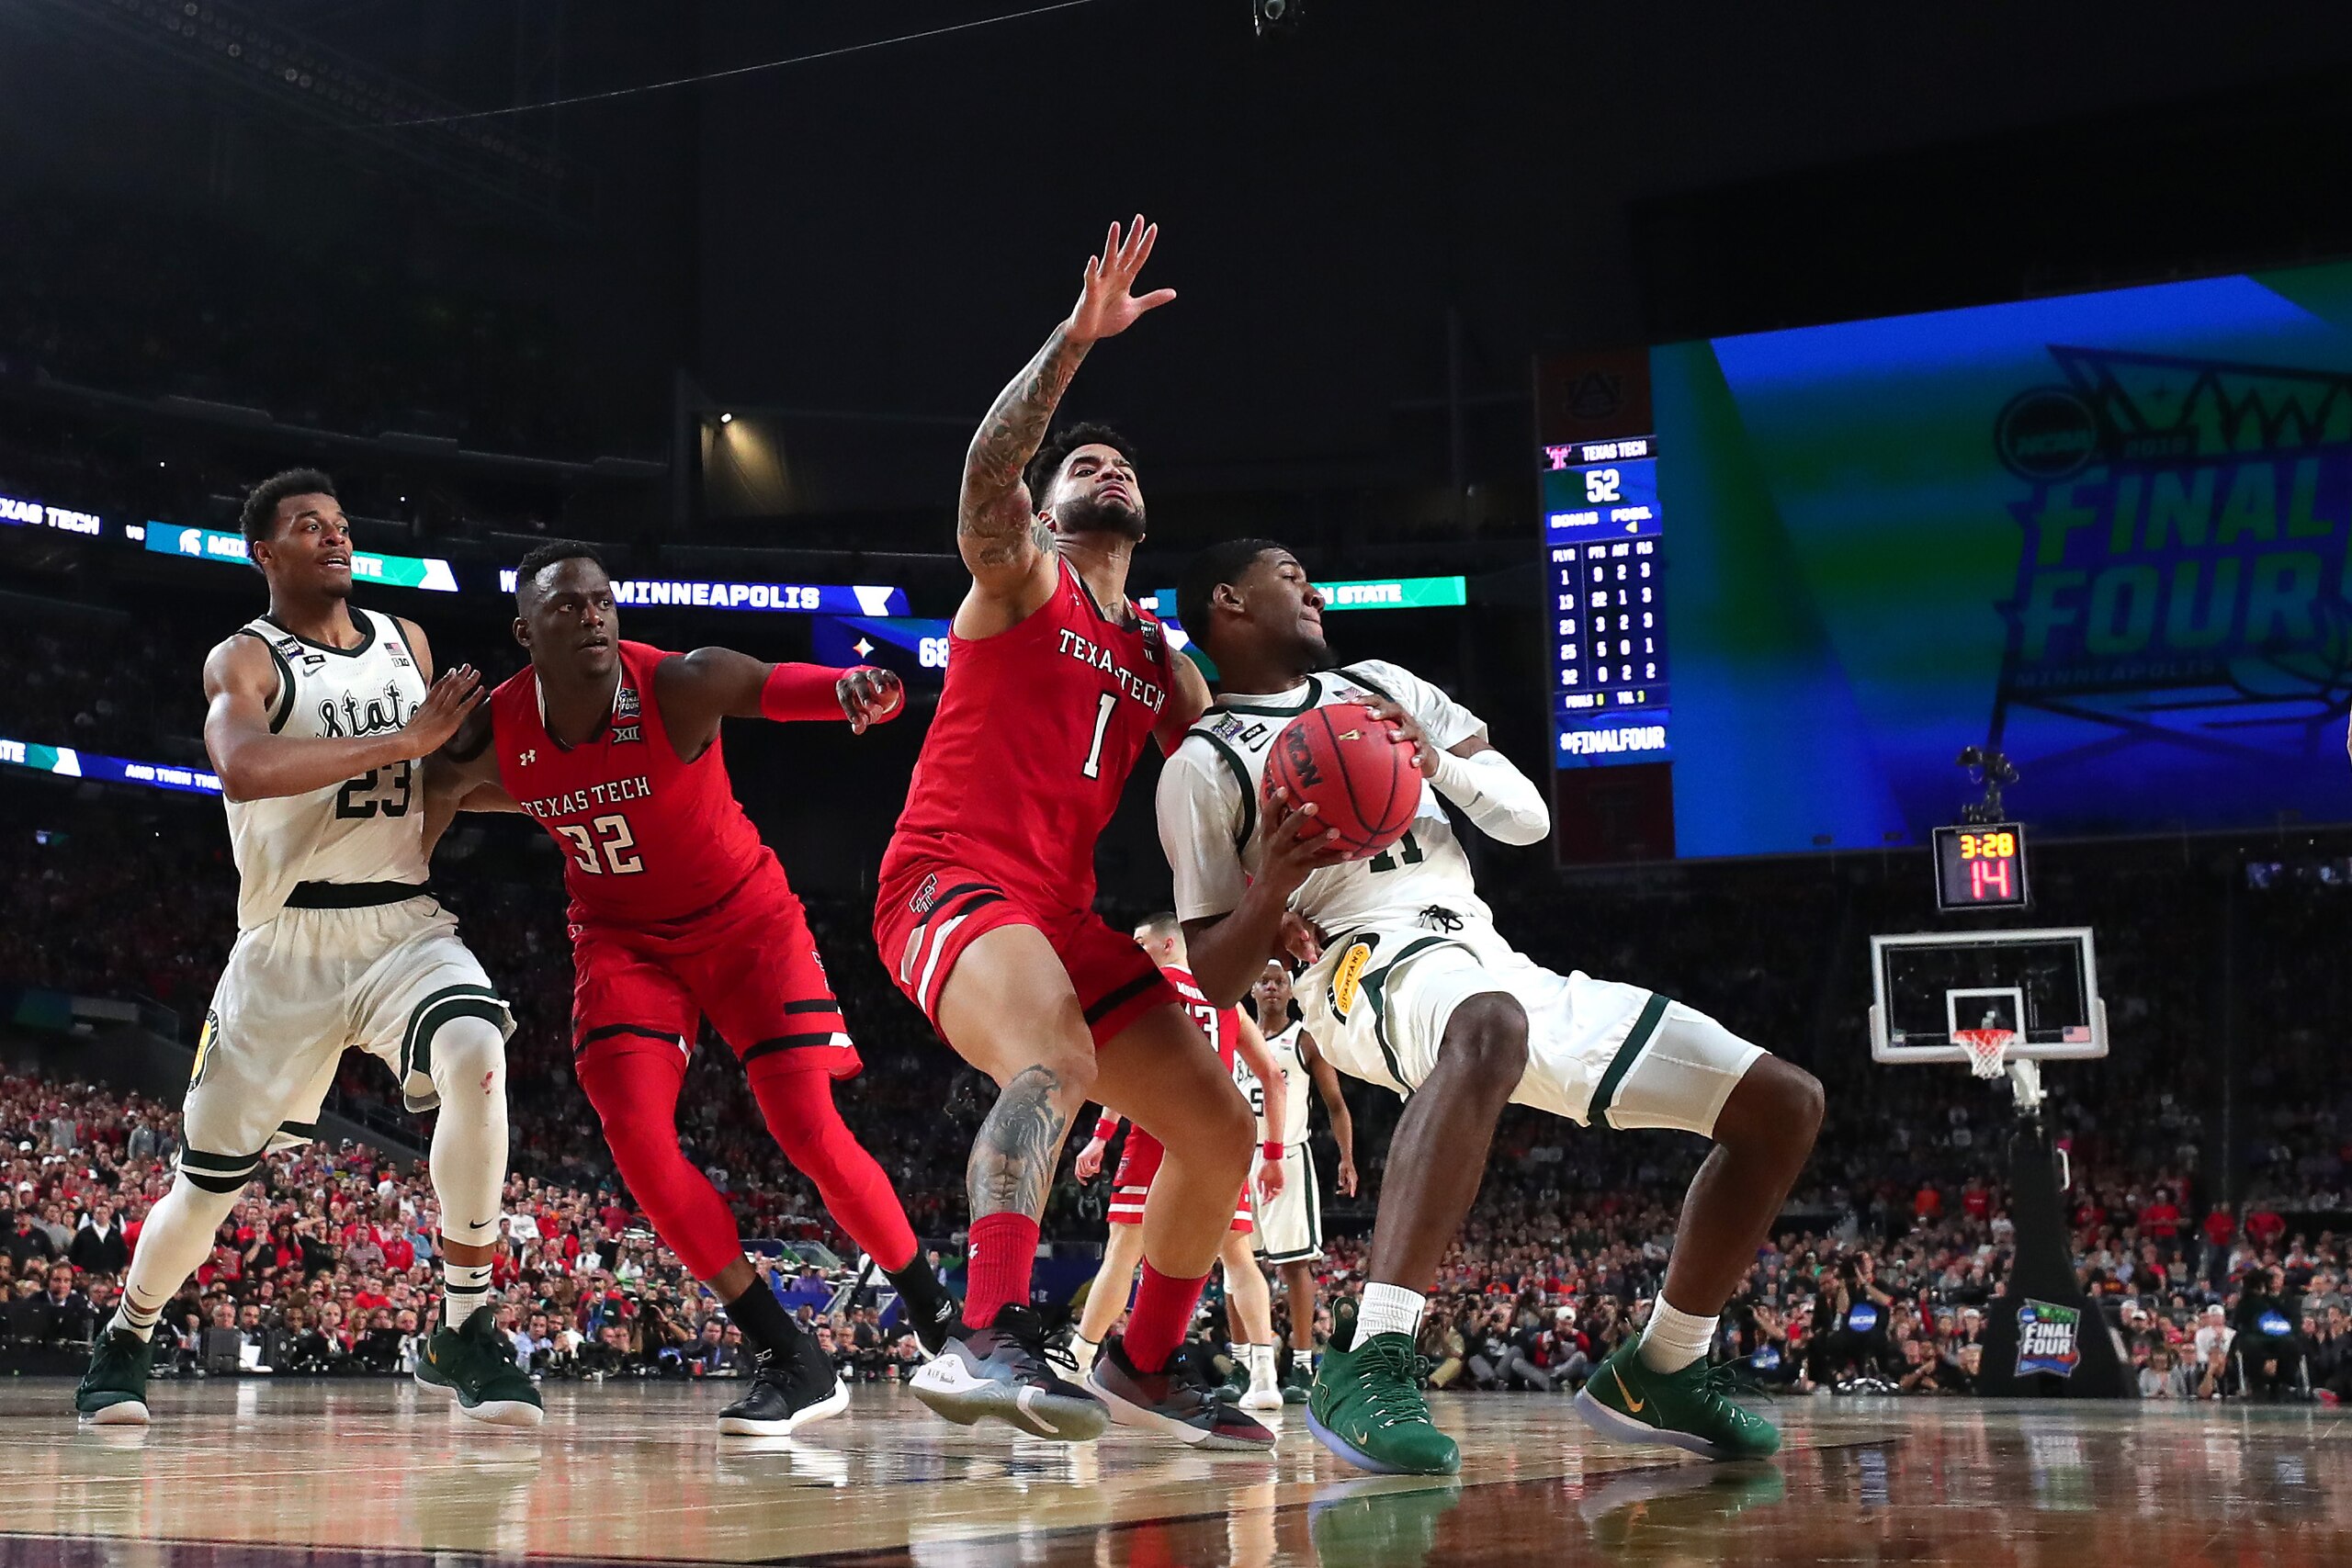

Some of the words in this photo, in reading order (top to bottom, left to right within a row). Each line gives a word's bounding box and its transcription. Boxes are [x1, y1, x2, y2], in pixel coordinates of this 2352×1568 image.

[1582, 444, 1616, 461] TEXAS
[1618, 440, 1646, 457] TECH
[1586, 468, 1620, 502] 52
[0, 498, 43, 525] XAS
[46, 506, 100, 536] TECH
[1551, 512, 1599, 528] BONUS
[2034, 458, 2335, 567] FINAL
[1588, 546, 1606, 559] PTS
[1562, 570, 1570, 585] 1
[1617, 564, 1627, 580] 2
[1641, 561, 1651, 578] 3
[608, 581, 820, 610] MINNEAPOLIS
[1337, 584, 1402, 604] STATE
[1559, 593, 1574, 610] 13
[1619, 589, 1627, 605] 1
[1642, 587, 1652, 604] 3
[2024, 548, 2323, 661] FOUR
[1596, 616, 1605, 633] 3
[1620, 614, 1629, 630] 2
[1643, 612, 1653, 628] 3
[1597, 641, 1607, 658] 5
[1621, 639, 1630, 656] 0
[1645, 637, 1654, 654] 1
[1059, 627, 1120, 680] TEXA
[1118, 666, 1166, 716] TECH
[1598, 666, 1608, 682] 0
[1622, 664, 1632, 681] 2
[1645, 662, 1656, 679] 2
[612, 726, 640, 743] XII
[1083, 692, 1117, 779] 1
[1560, 726, 1666, 754] #FINALFOUR
[125, 763, 155, 781] AND
[155, 768, 192, 786] THEN
[335, 759, 412, 819] 23
[521, 790, 590, 818] TEXAS
[591, 776, 652, 805] TECH
[556, 814, 643, 874] 32
[1960, 832, 2015, 860] 3:28
[1971, 859, 2010, 899] 14
[2025, 1322, 2074, 1338] FINAL
[2023, 1337, 2072, 1355] FOUR
